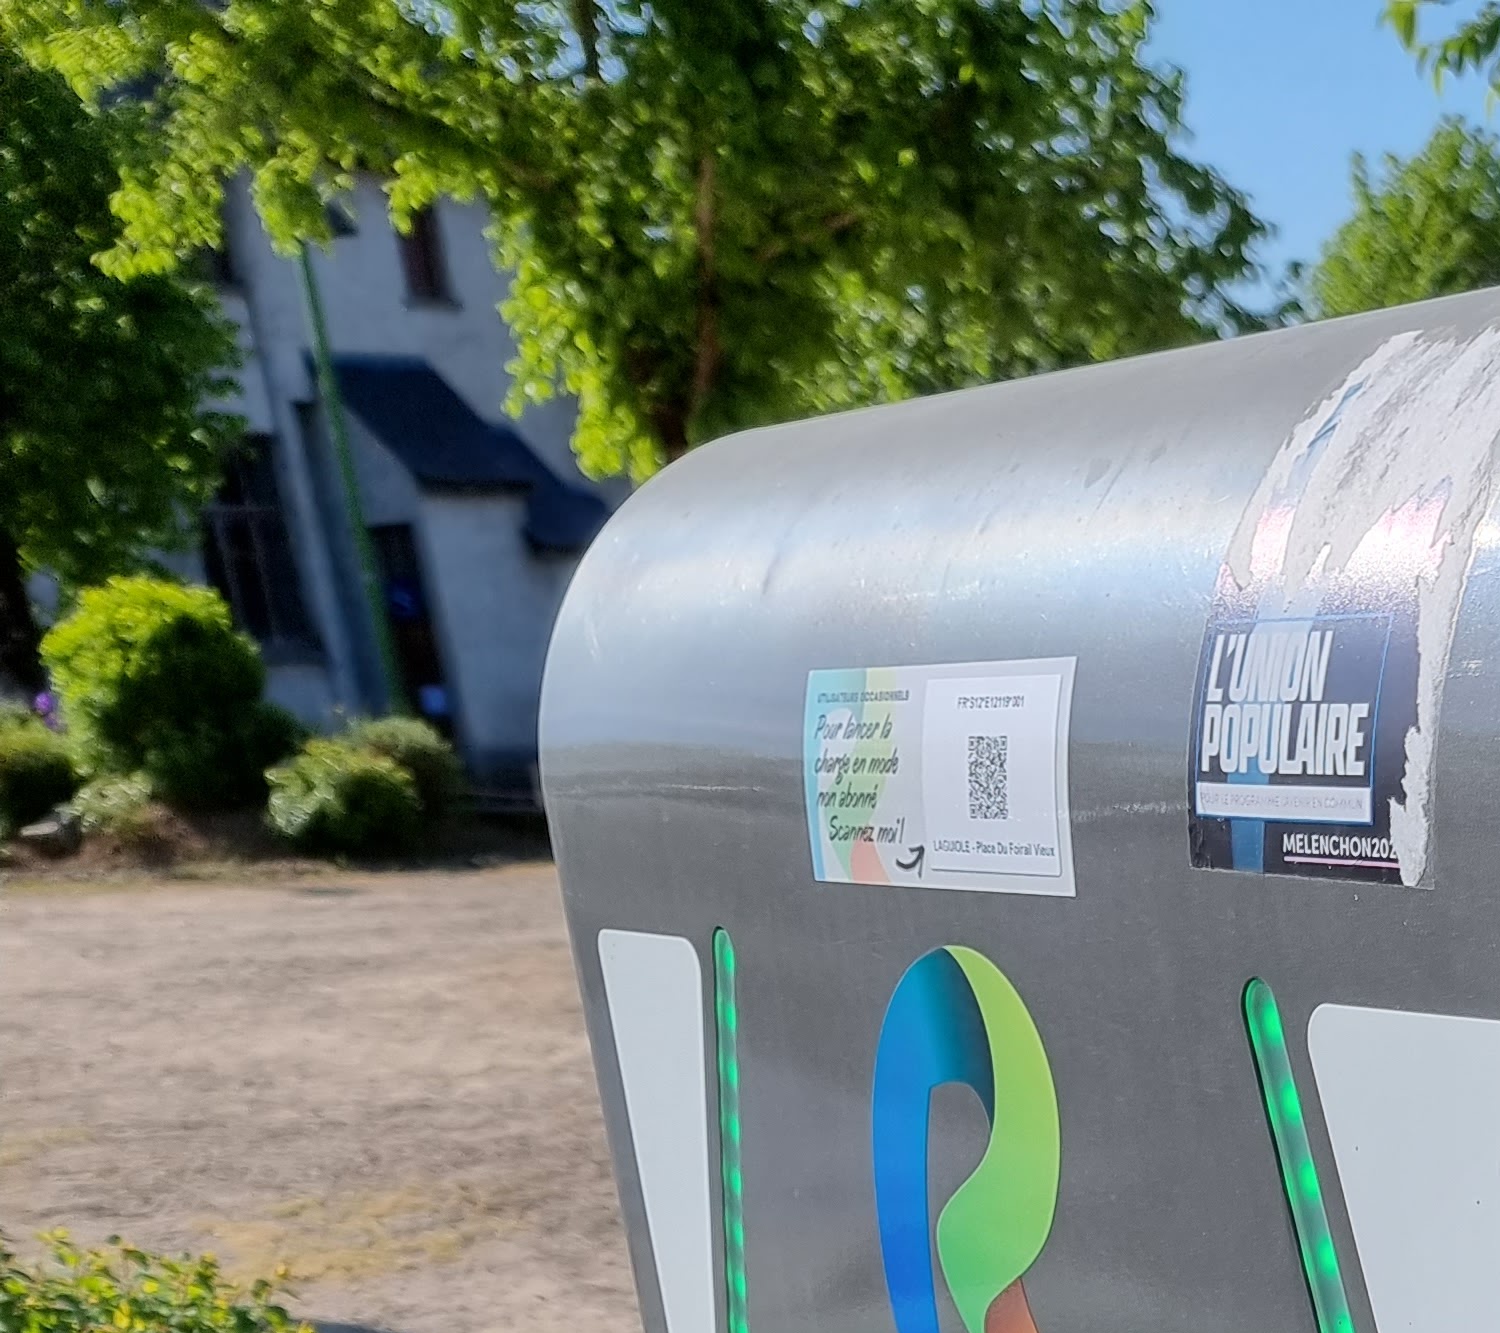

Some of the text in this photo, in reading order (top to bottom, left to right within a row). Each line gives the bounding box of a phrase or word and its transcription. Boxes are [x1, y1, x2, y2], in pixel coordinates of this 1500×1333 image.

[1206, 630, 1334, 702] L'UNION
[814, 712, 893, 740] Pour lancer la
[1201, 703, 1369, 776] POPULAIRE
[814, 747, 899, 786] charge en mode
[816, 781, 879, 809] non abonné
[829, 814, 875, 842] Scannez
[933, 840, 970, 854] LAGUIOLE
[976, 841, 996, 855] Place
[997, 842, 1008, 855] Du
